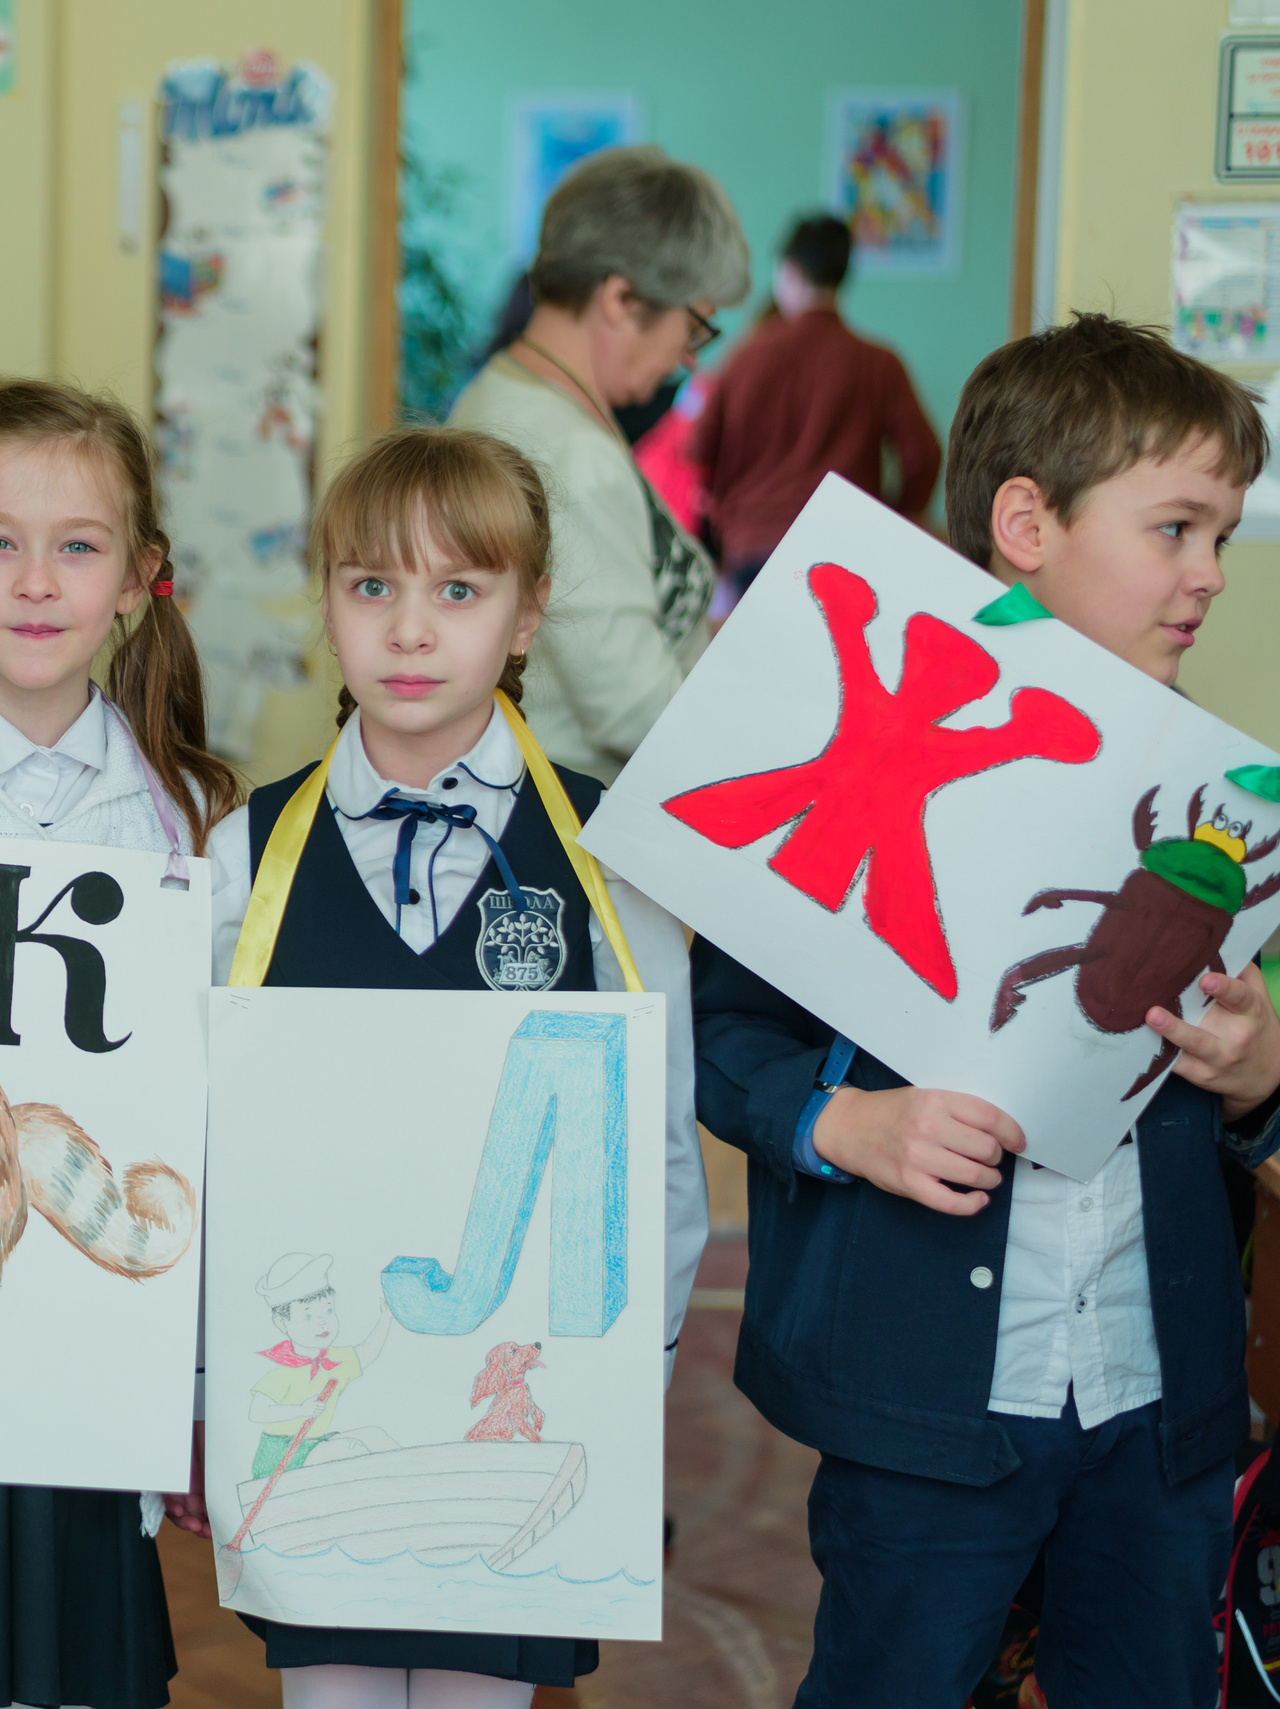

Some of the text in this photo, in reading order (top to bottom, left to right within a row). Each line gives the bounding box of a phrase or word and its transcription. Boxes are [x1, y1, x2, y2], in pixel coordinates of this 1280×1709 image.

[661, 561, 1102, 1002] Ж
[490, 896, 554, 909] ШЛА
[506, 967, 538, 980] 875
[381, 1010, 627, 1338] Л
